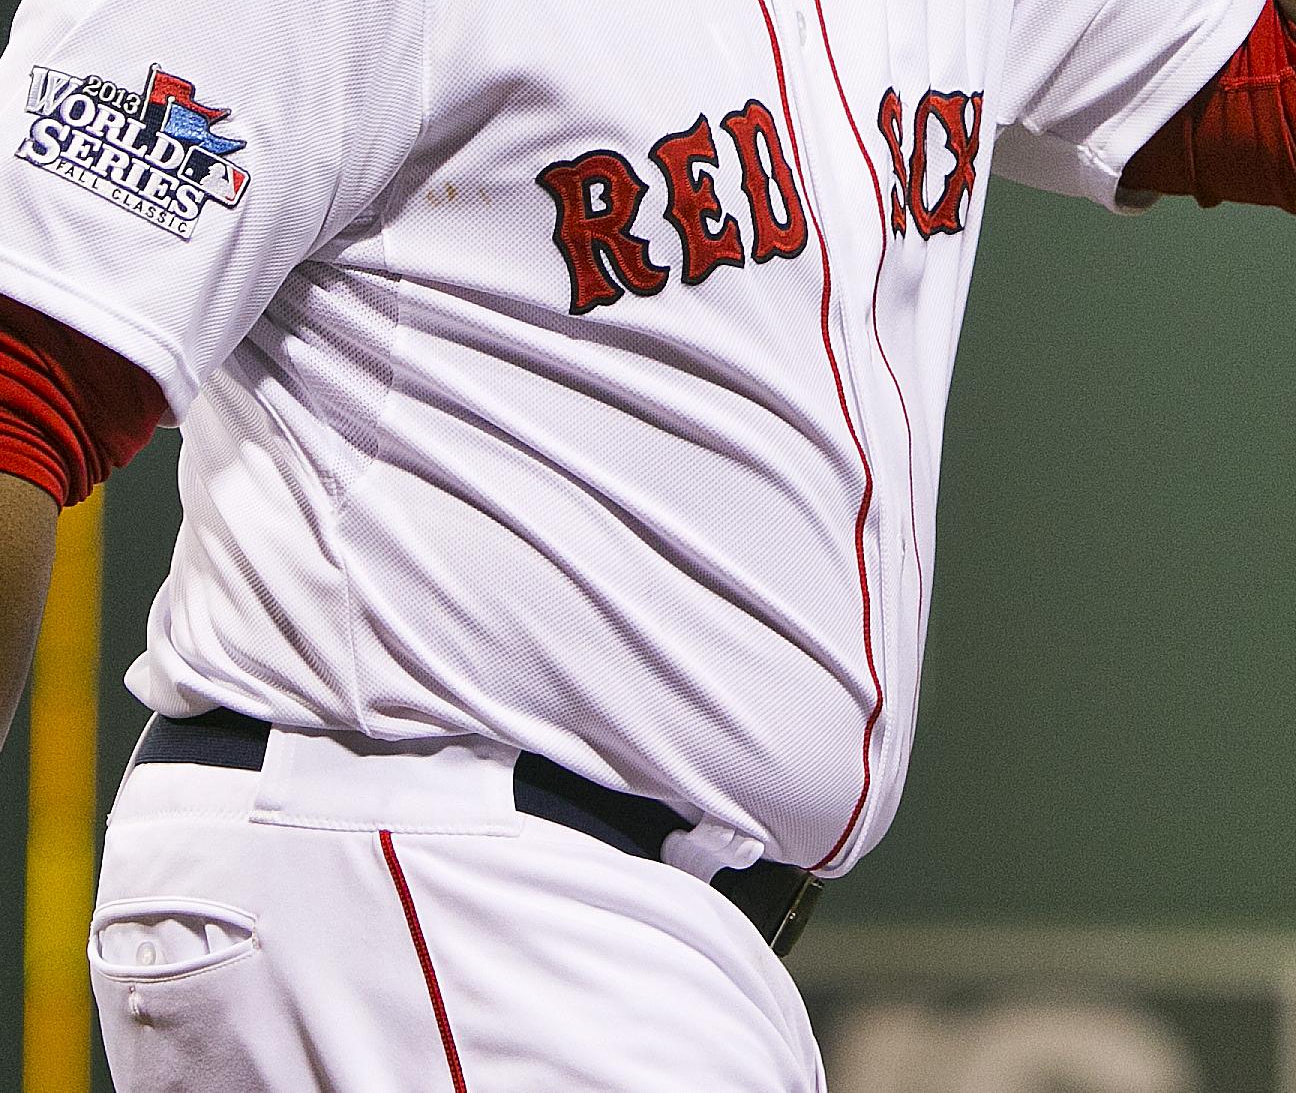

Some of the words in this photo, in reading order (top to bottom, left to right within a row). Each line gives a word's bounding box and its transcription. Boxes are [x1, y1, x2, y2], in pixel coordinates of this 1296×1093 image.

[25, 65, 185, 171] WORLD
[82, 75, 142, 115] 2013
[14, 116, 206, 222] SERIES
[56, 158, 100, 190] FALL
[111, 188, 188, 234] CLASSIC
[536, 98, 808, 315] RED
